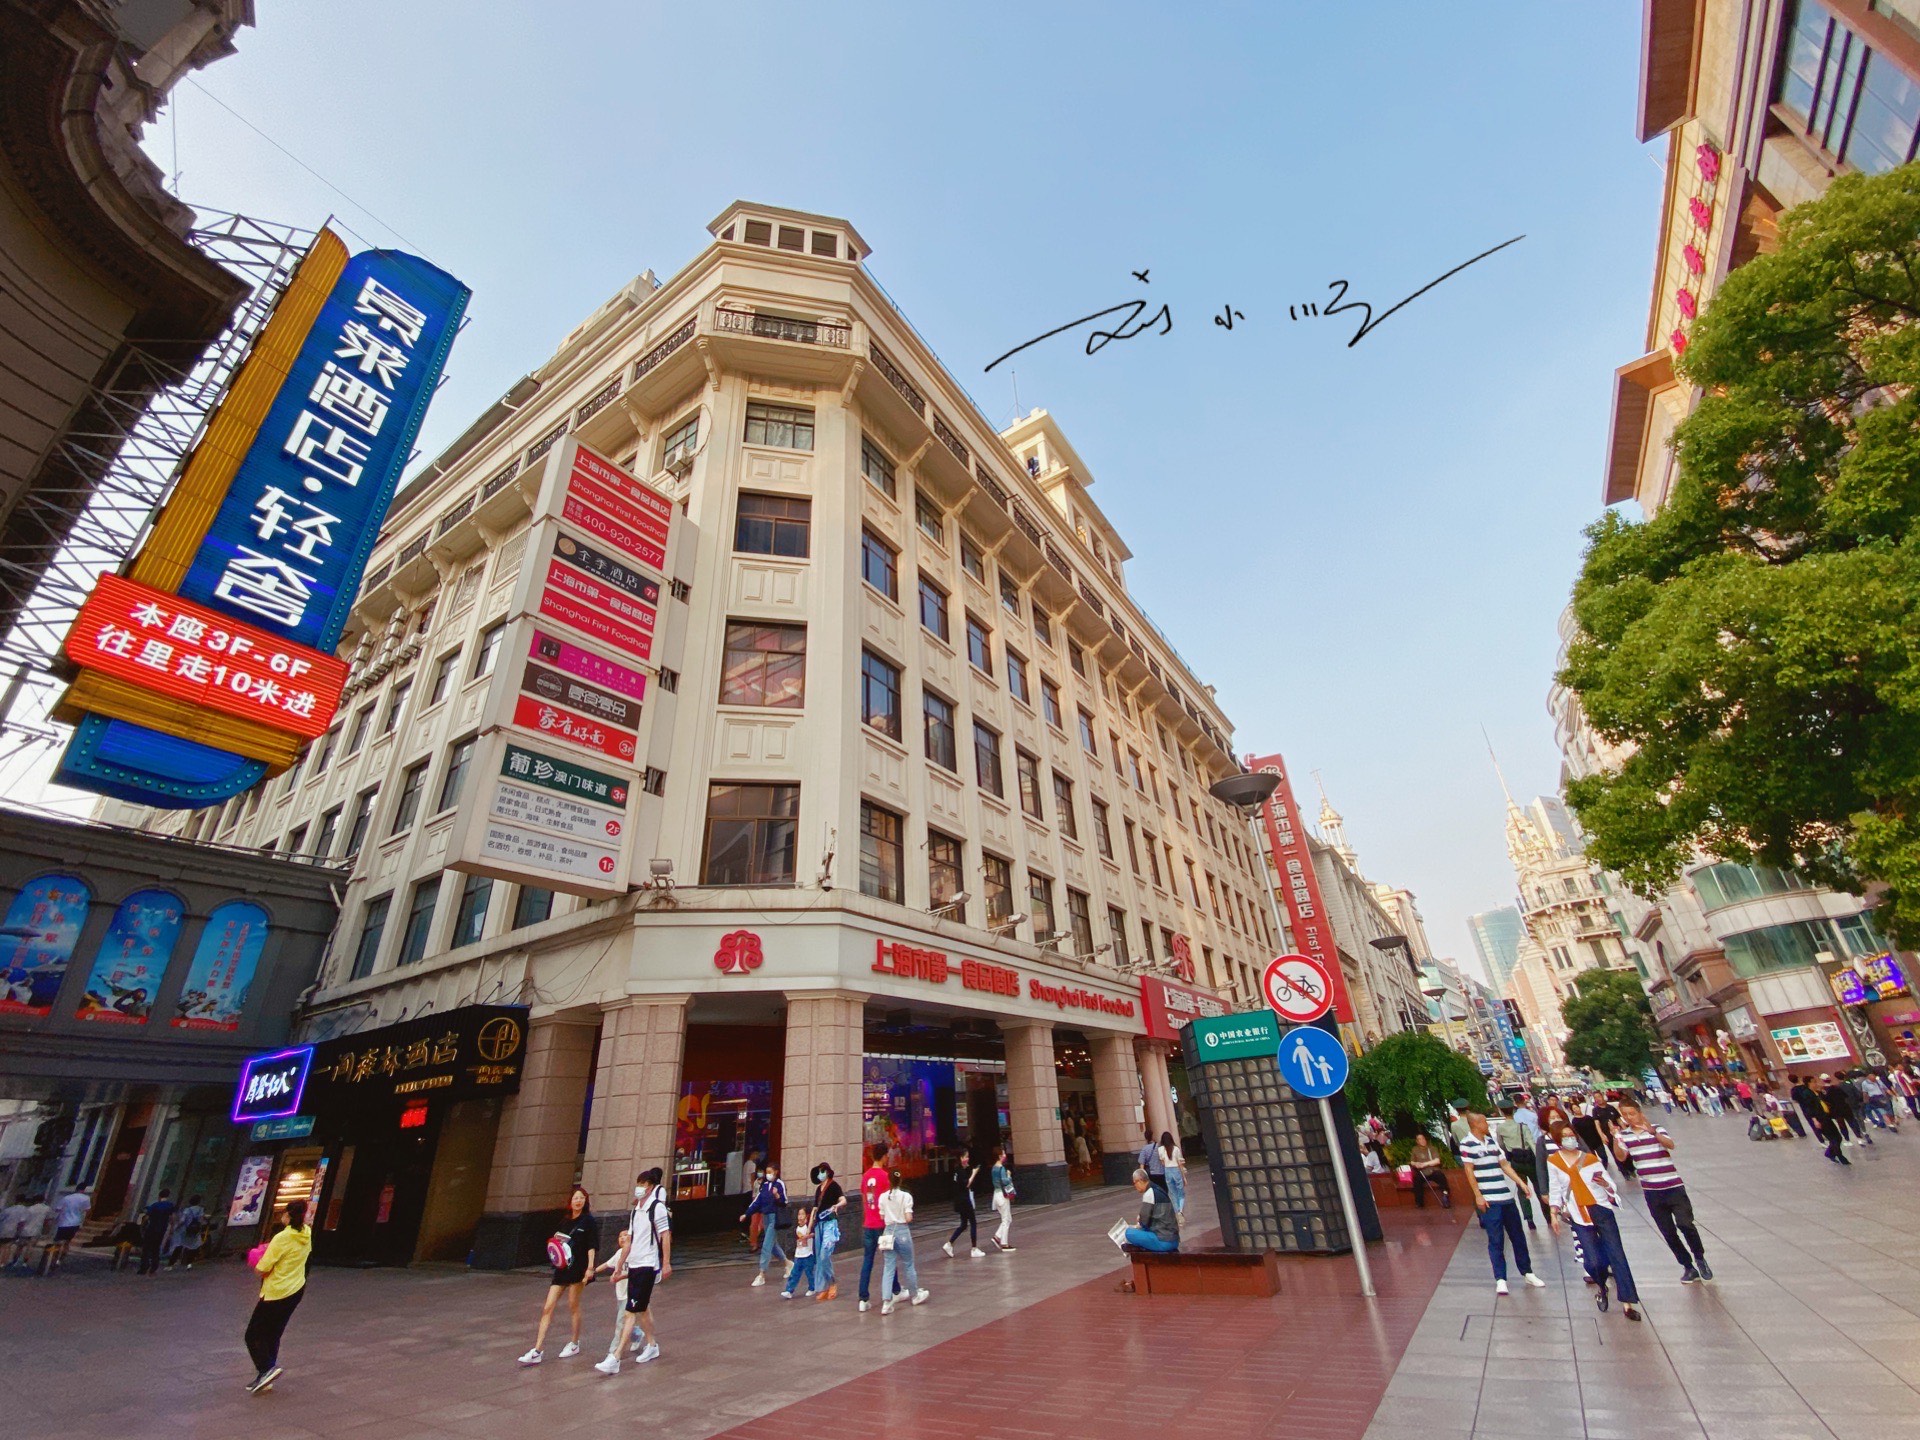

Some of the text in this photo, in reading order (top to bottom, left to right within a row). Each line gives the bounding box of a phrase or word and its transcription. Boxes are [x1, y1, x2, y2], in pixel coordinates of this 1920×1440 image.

[577, 454, 670, 517] 上海市第一食品商店
[572, 480, 667, 540] Shanghai First Foodhall
[583, 515, 663, 563] 400-920-2577
[578, 549, 638, 589] 全季酒店
[549, 568, 654, 626] 上海市第一食品商店
[543, 597, 649, 651] Shanghai First Foodhall
[96, 623, 318, 719] 往里走10米进
[538, 706, 606, 746] 家有好面
[620, 742, 633, 756] 3F
[509, 751, 555, 780] 葡珍
[553, 769, 608, 797] 澳门味道
[612, 788, 626, 801] 3F
[608, 823, 621, 835] 2F
[602, 859, 615, 871] 1F
[1269, 790, 1315, 919] 上海市第一食品商店
[1305, 926, 1322, 951] First
[871, 938, 1021, 997] 上海市第一食品商店
[1029, 978, 1080, 1010] Shanghai
[1098, 994, 1135, 1018] Foodhall
[1219, 1026, 1269, 1040] 中国农业银行
